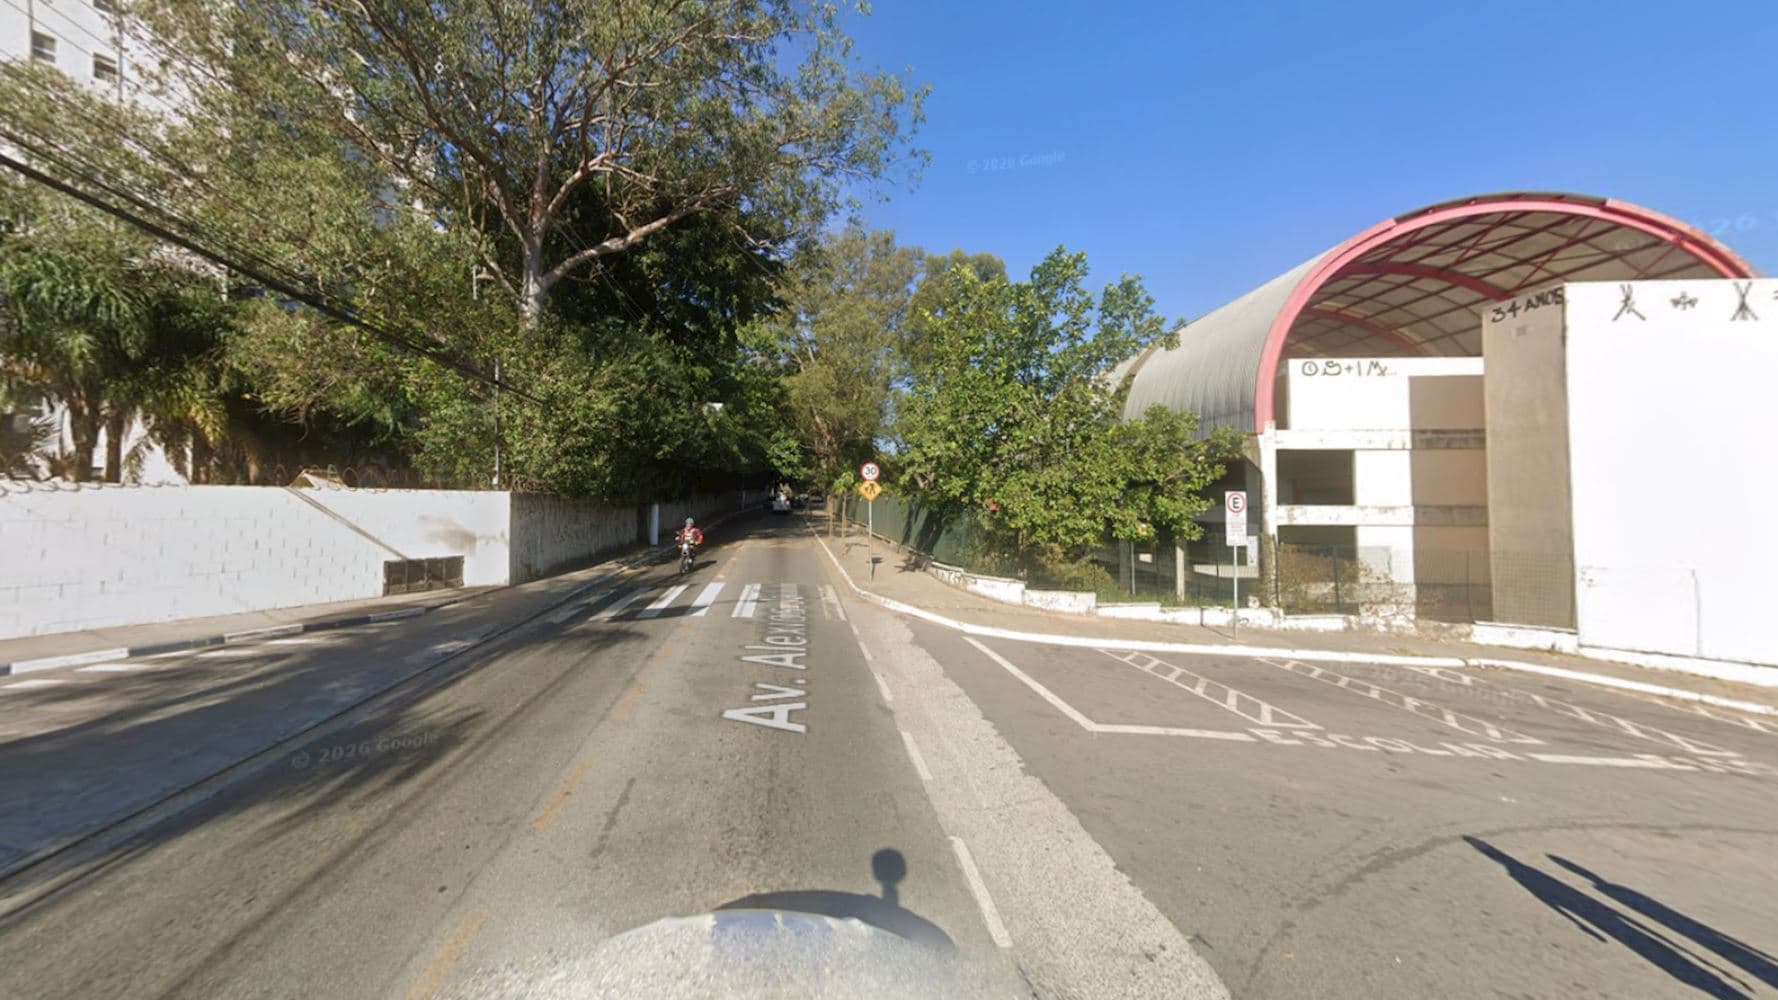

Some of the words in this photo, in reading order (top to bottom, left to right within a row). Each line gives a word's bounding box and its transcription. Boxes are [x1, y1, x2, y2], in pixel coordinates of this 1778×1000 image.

[1491, 301, 1521, 323] 34
[864, 466, 877, 476] 30
[1232, 496, 1241, 509] E
[1245, 727, 1526, 760] ESCOLAR
